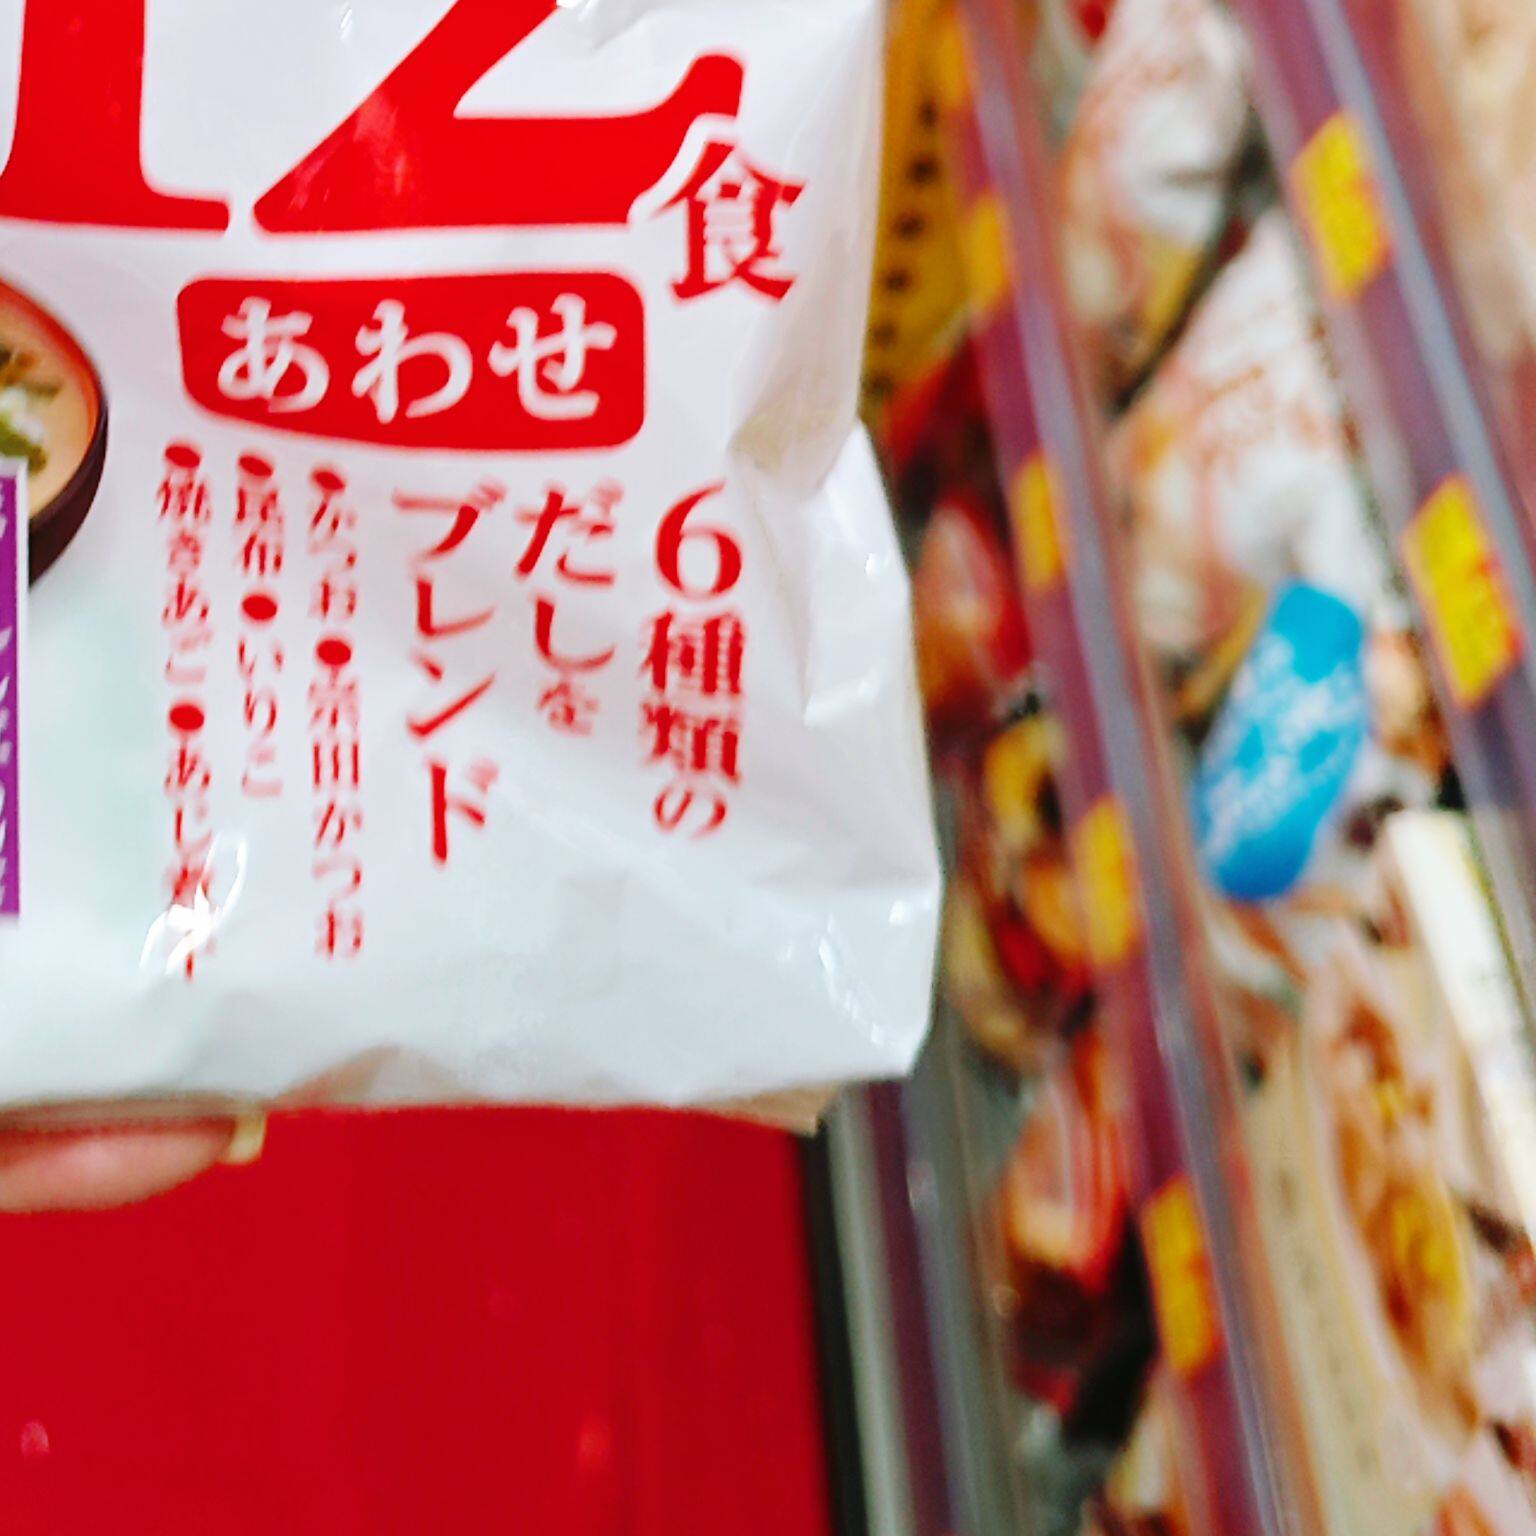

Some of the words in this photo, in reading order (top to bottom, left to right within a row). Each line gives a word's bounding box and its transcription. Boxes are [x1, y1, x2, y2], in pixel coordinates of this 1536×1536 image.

[217, 294, 618, 422] あわせ
[390, 478, 507, 868] ブレンド
